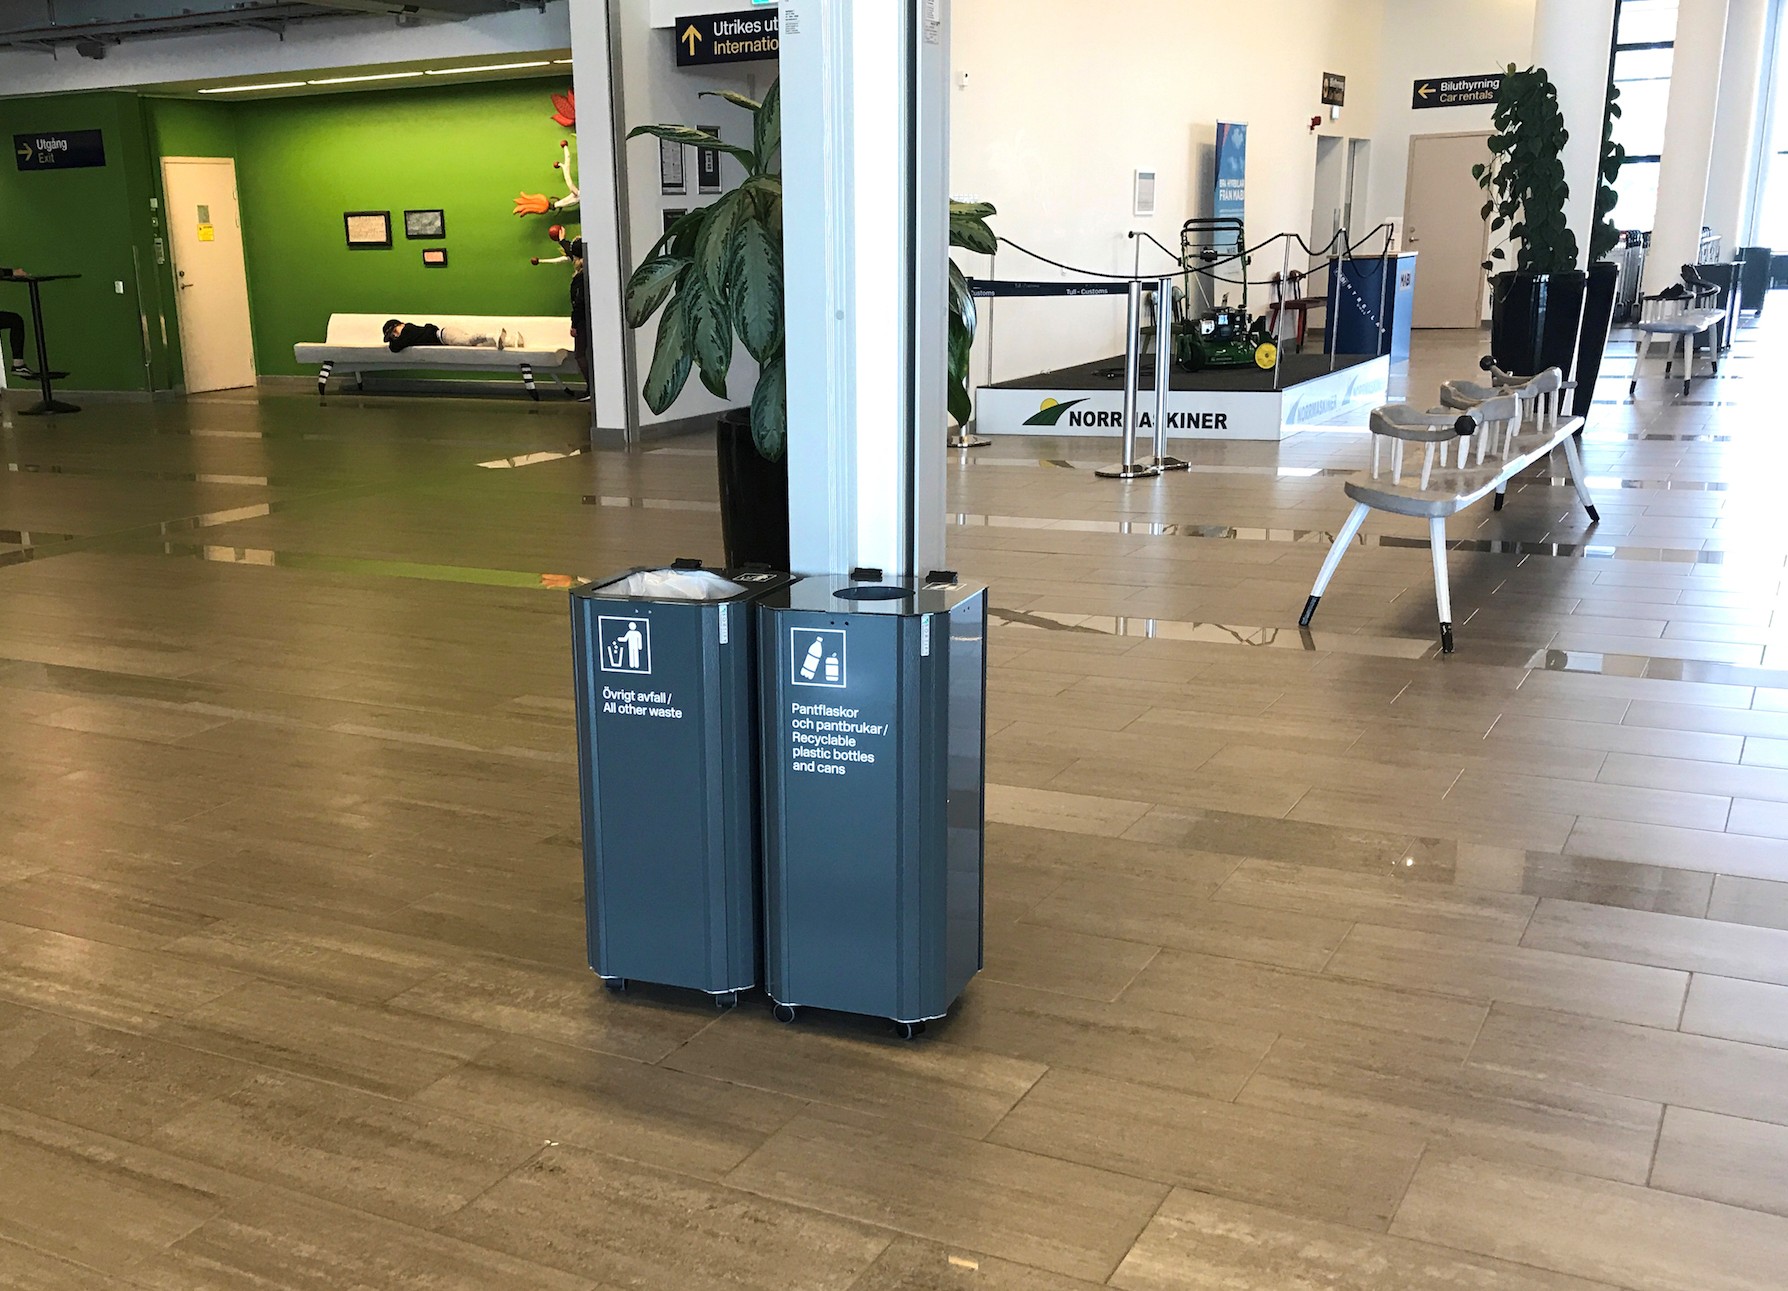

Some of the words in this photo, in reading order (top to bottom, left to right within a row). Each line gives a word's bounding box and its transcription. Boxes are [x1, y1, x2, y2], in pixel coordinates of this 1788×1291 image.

[713, 19, 761, 36] Utrikes
[714, 36, 778, 55] Internatio
[1441, 79, 1500, 91] Biluthyrning
[1440, 93, 1457, 103] Car
[1459, 90, 1493, 101] rentals
[36, 137, 67, 152] Utgång
[38, 153, 55, 163] Exit
[1069, 411, 1228, 429] NORRAKINER
[602, 686, 636, 703] Övrigt
[603, 702, 617, 713] All
[618, 703, 647, 716] other
[649, 706, 683, 719] waste
[791, 702, 859, 719] Pantflaskor
[792, 718, 814, 730] och
[792, 731, 857, 748] Recyclable
[792, 745, 831, 759] plastic
[833, 748, 875, 764] bottles
[792, 761, 815, 773] and
[817, 764, 846, 776] cans
